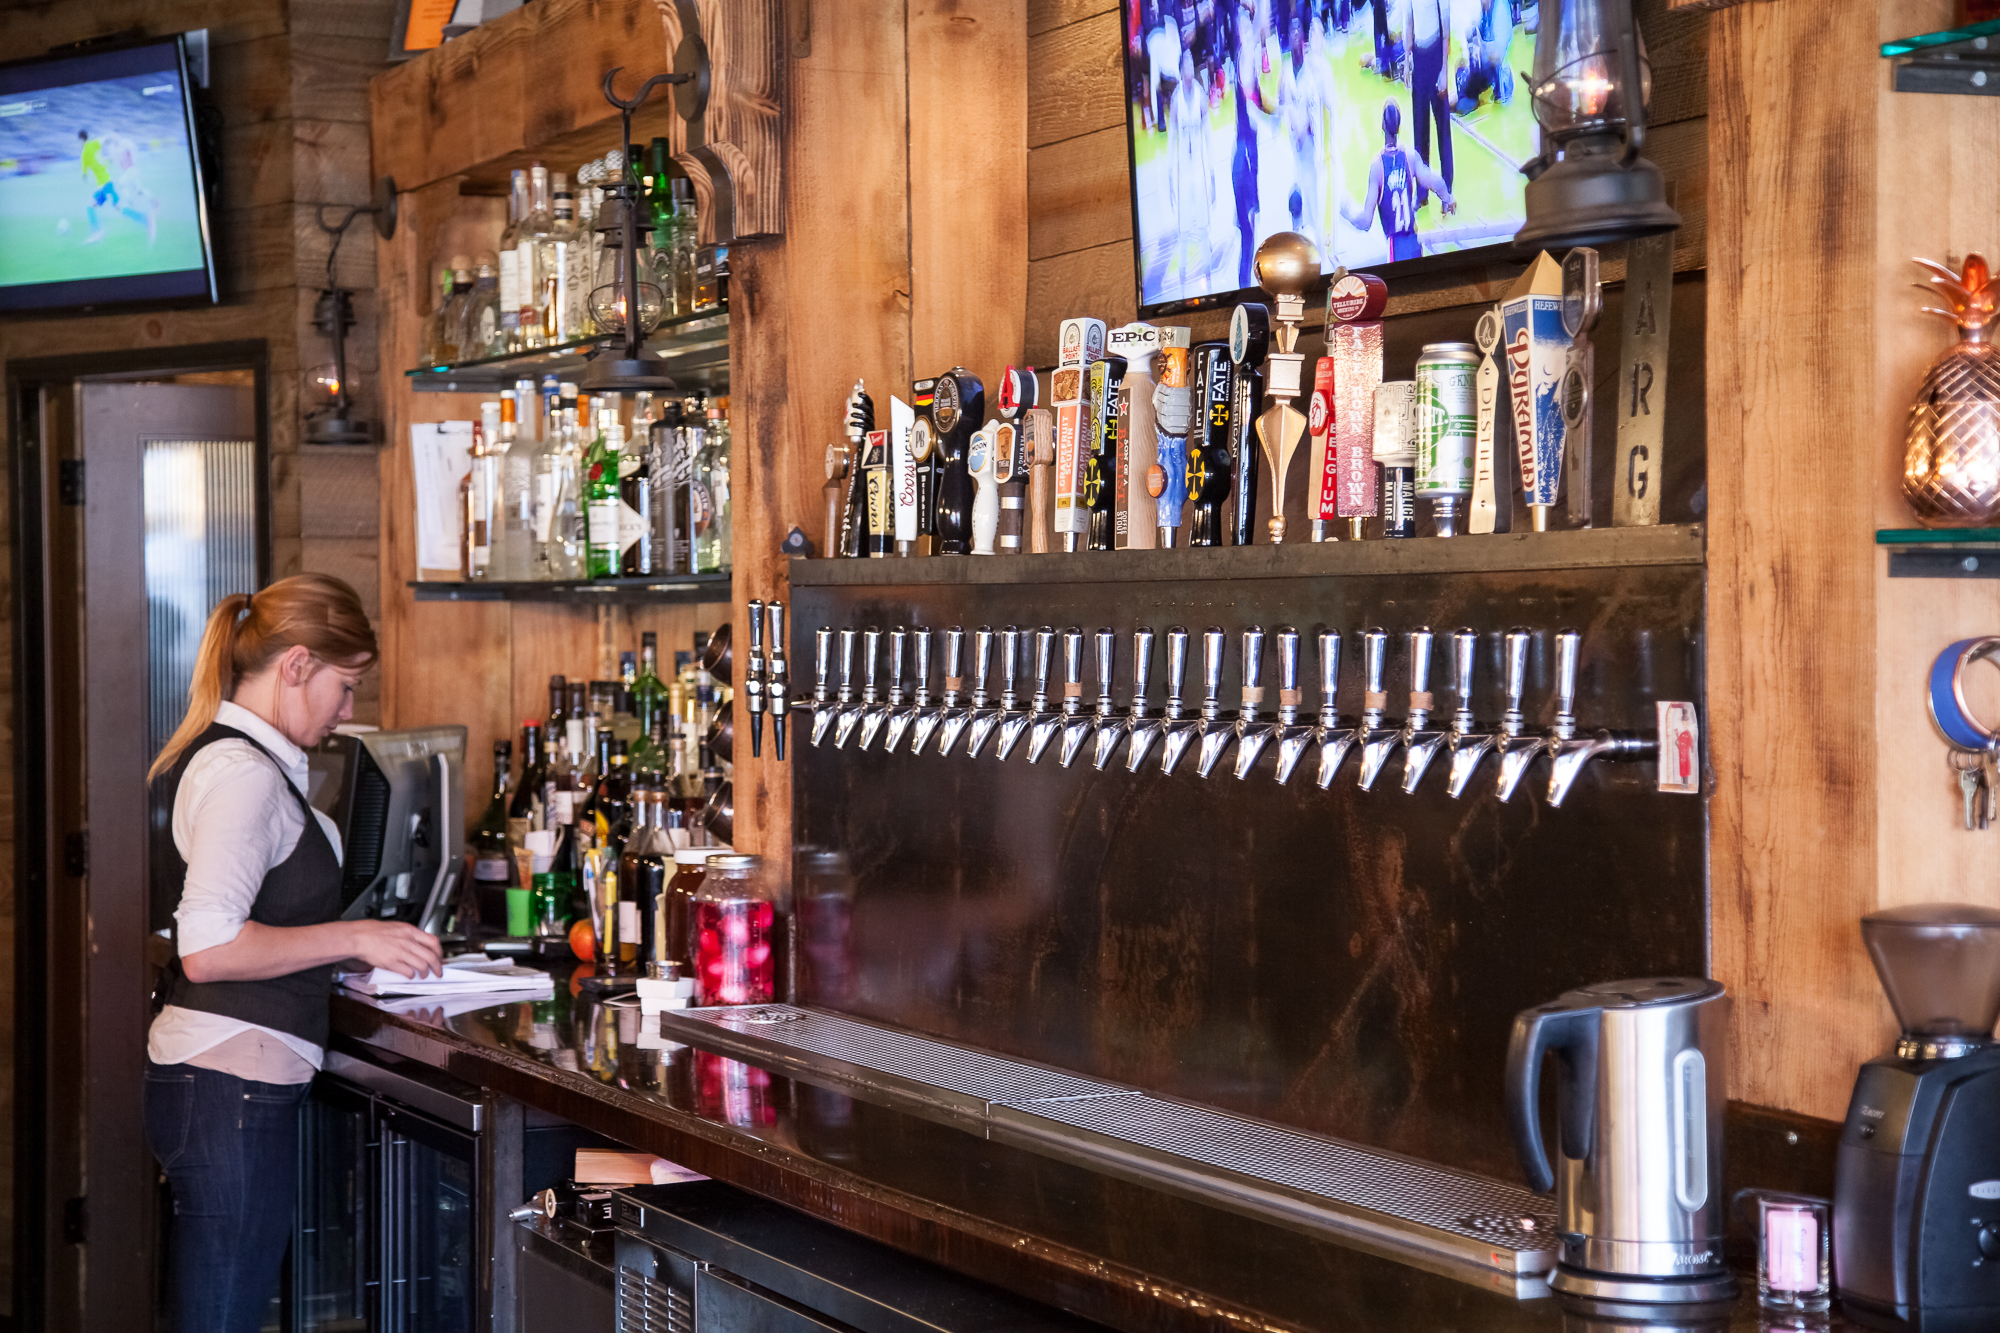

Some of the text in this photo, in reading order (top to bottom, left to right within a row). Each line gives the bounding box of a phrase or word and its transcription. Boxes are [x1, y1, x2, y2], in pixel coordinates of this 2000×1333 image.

[1333, 299, 1364, 308] TELLURIDE
[1534, 300, 1562, 311] HEFEW
[1063, 345, 1080, 354] BALLAST
[1086, 345, 1102, 355] BALLAST
[1628, 236, 1662, 500] ARG
[1107, 379, 1121, 417] FATE
[1196, 352, 1204, 427] FATE
[1212, 361, 1227, 401] FATE
[1449, 374, 1477, 387] G'KNIG
[1232, 377, 1240, 458] AMERICAN
[1347, 327, 1366, 506] FACE DOWN BROWN
[1479, 387, 1493, 488] DESTIHL
[971, 441, 988, 452] MOON
[1059, 415, 1069, 487] GRAPEFRUIT
[1065, 428, 1074, 475] SCULPIN
[1078, 414, 1089, 487] GRAPEFRUIT
[1117, 427, 1127, 503] BAPTIST
[1321, 423, 1336, 514] BELGIUM
[868, 475, 880, 529] Coors
[899, 464, 916, 507] Coors
[1385, 481, 1393, 521] MALICE
[1402, 481, 1414, 521] MALICE
